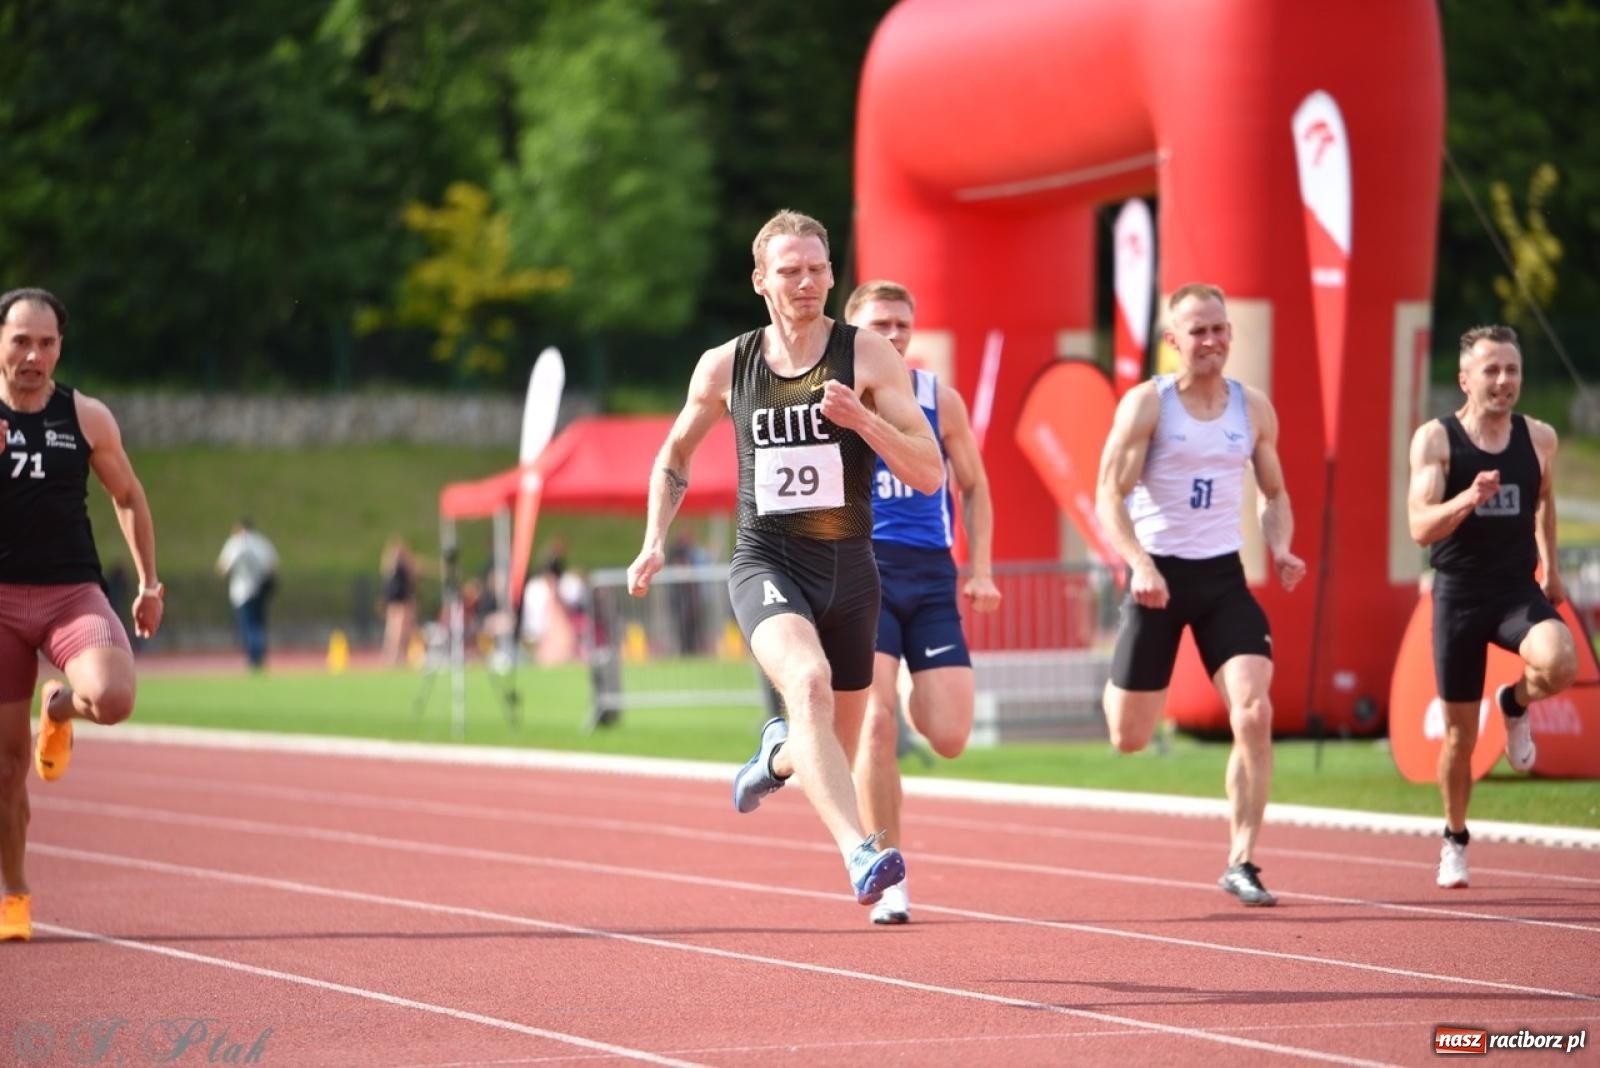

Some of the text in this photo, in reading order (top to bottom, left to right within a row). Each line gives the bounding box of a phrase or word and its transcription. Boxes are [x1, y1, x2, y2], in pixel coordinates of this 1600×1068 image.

[752, 403, 830, 446] ELITE
[10, 452, 46, 479] 71
[776, 465, 820, 497] 29
[1190, 478, 1214, 509] 51
[762, 579, 788, 606] A
